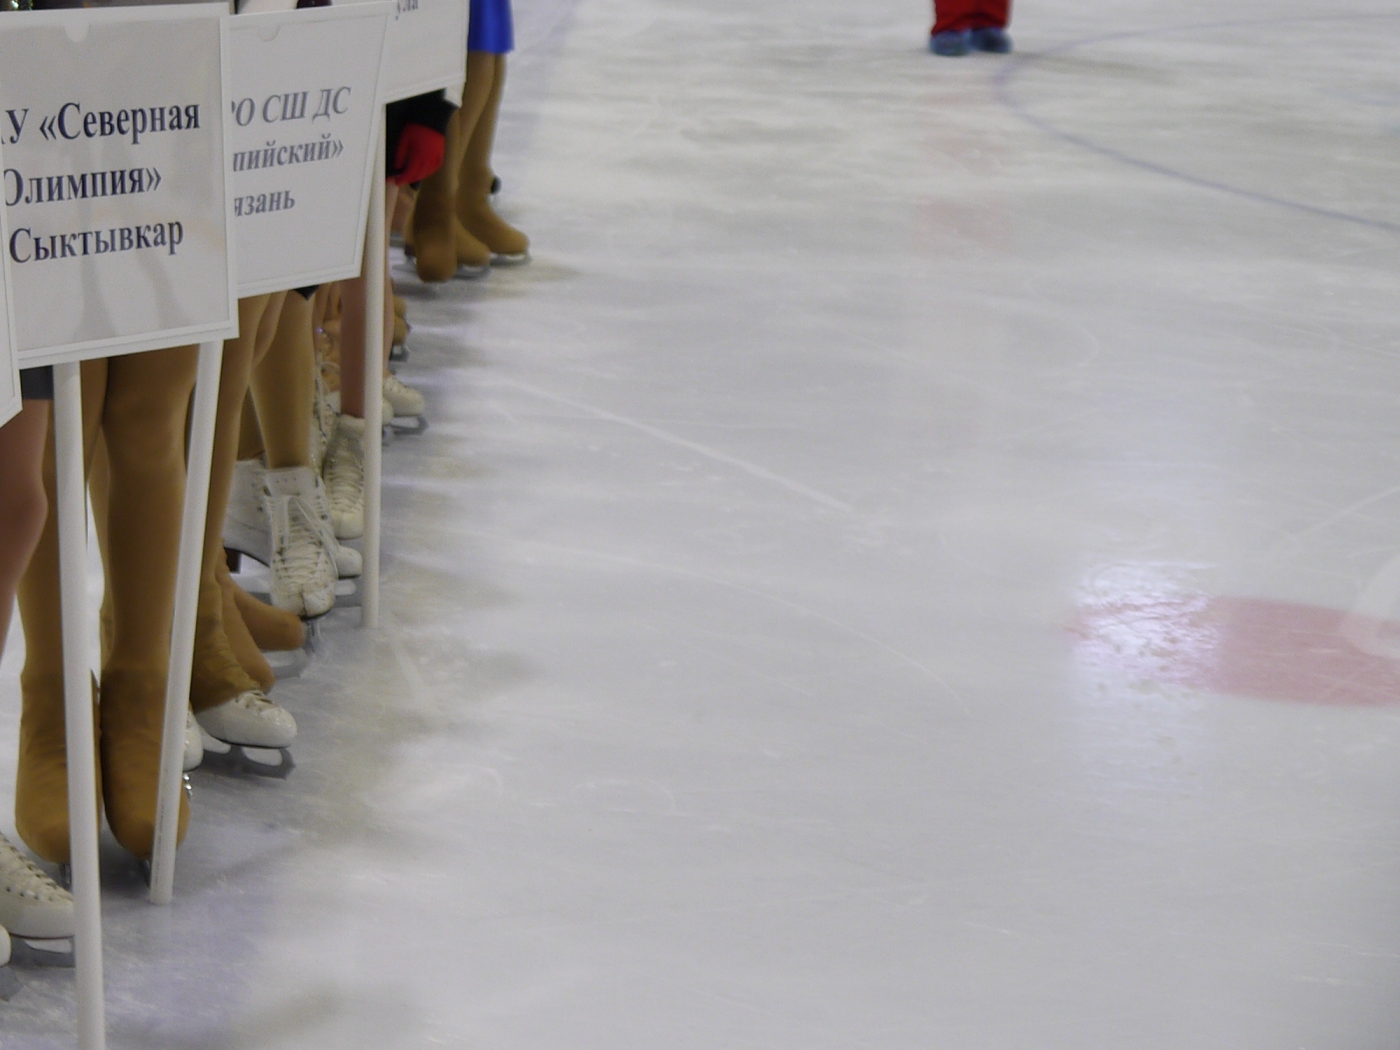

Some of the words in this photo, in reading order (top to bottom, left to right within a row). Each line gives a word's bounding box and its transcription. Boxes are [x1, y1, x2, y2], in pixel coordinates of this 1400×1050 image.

[38, 101, 201, 146] «Северная
[261, 90, 310, 123] СШ
[311, 85, 352, 124] ДС
[232, 132, 344, 172] пийский»
[3, 167, 162, 207] Олимпия»
[234, 190, 296, 217] язань
[9, 220, 184, 264] Сыктывкар
